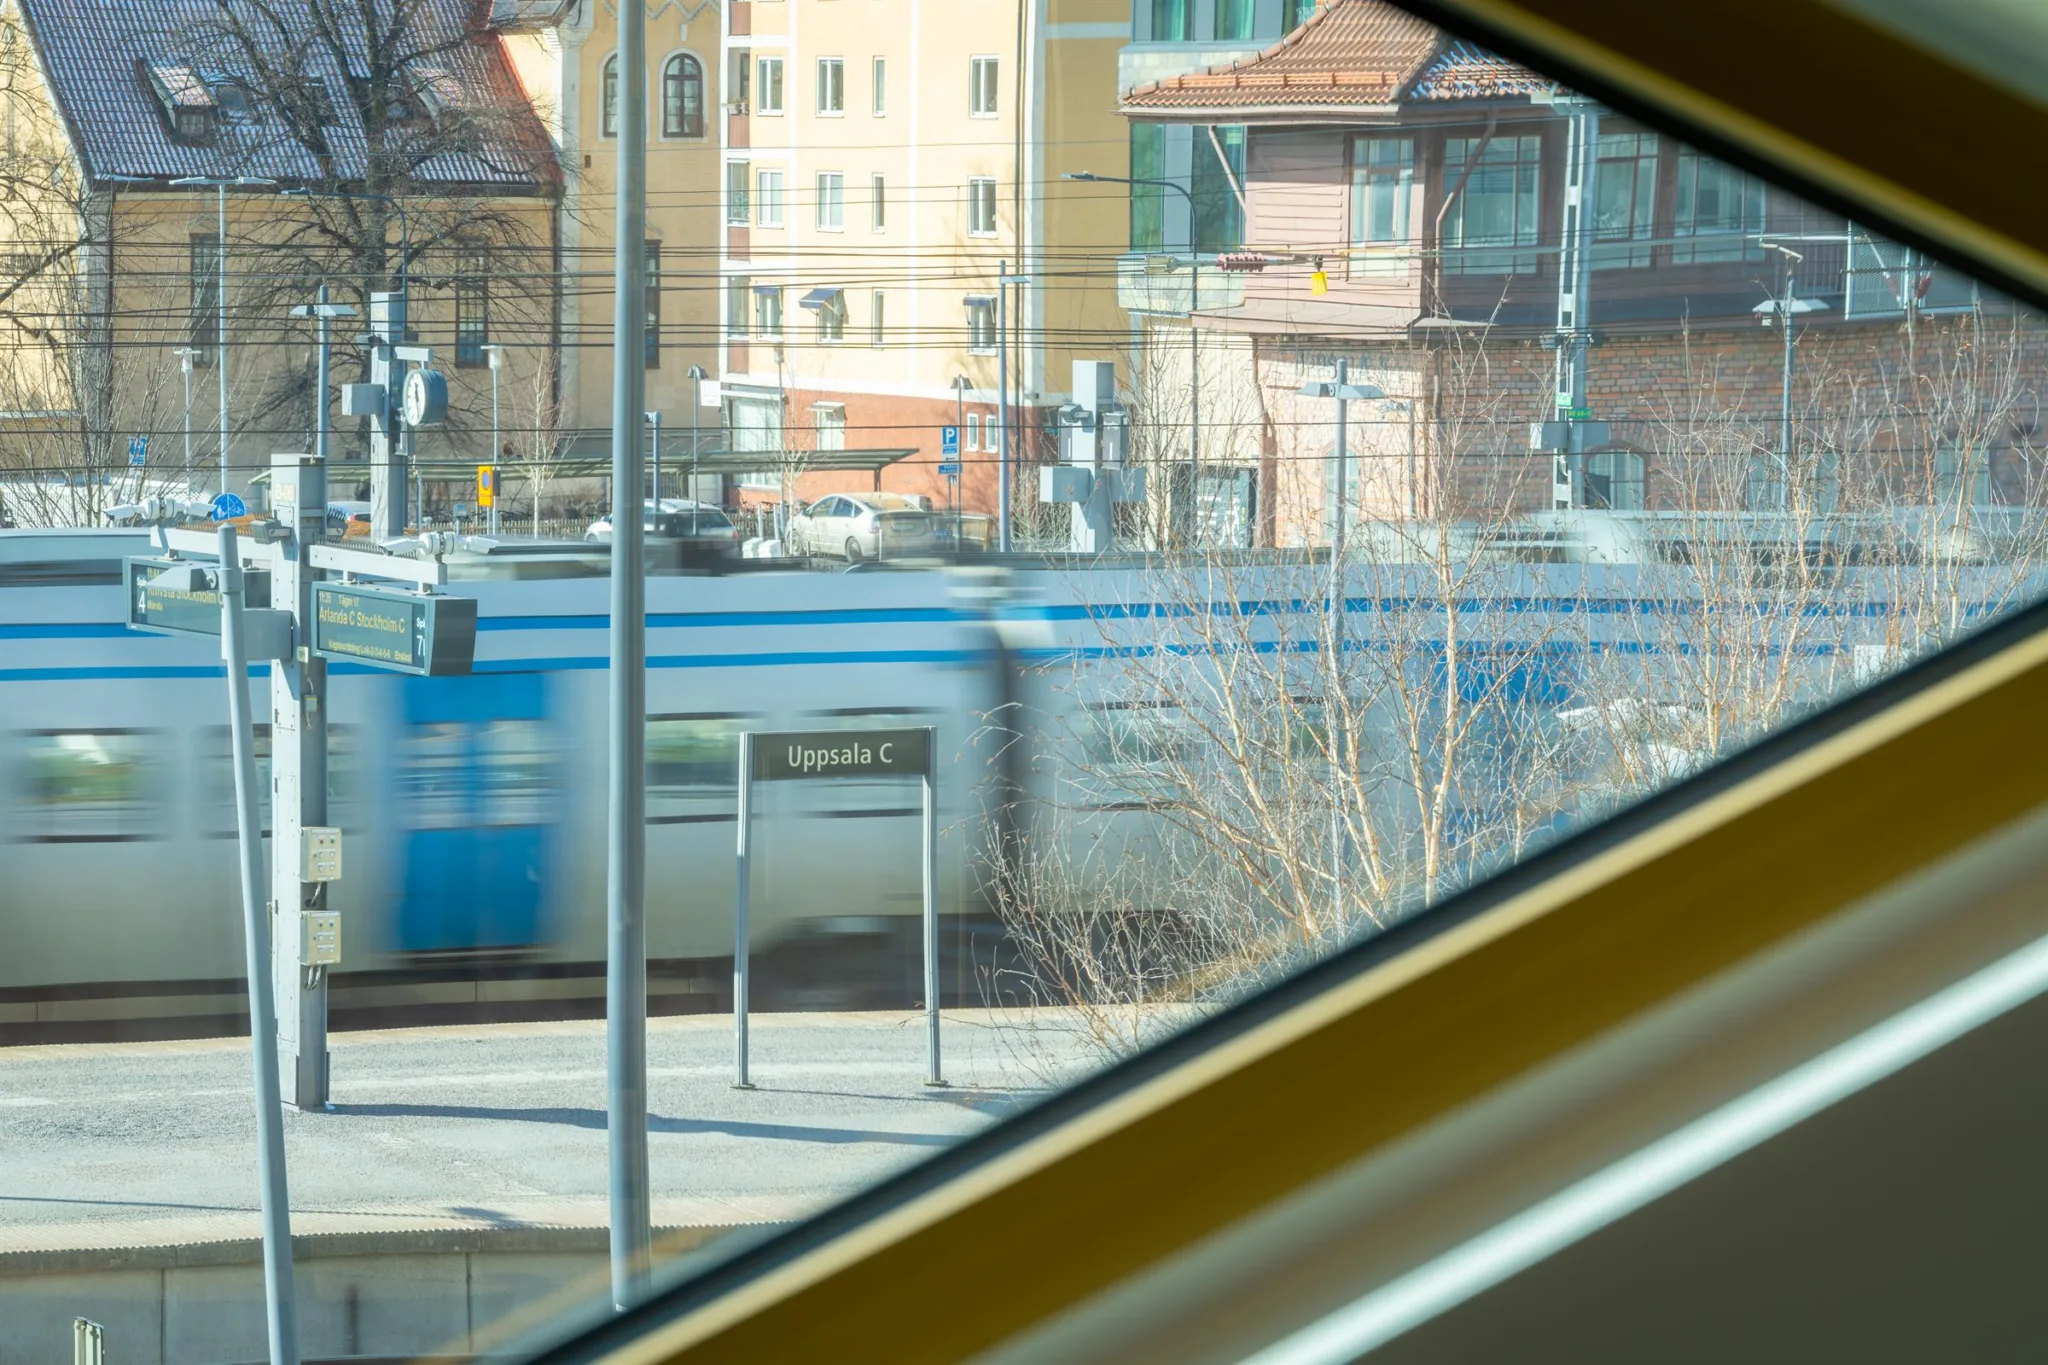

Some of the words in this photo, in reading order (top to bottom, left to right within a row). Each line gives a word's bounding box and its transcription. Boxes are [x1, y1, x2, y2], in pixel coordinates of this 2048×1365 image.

[946, 428, 955, 444] P
[138, 591, 145, 613] 4
[320, 607, 347, 624] Arlanda
[349, 611, 355, 625] C
[357, 612, 397, 631] Stockholm
[399, 619, 405, 633] C
[788, 743, 872, 772] Uppsala
[879, 743, 893, 763] C
